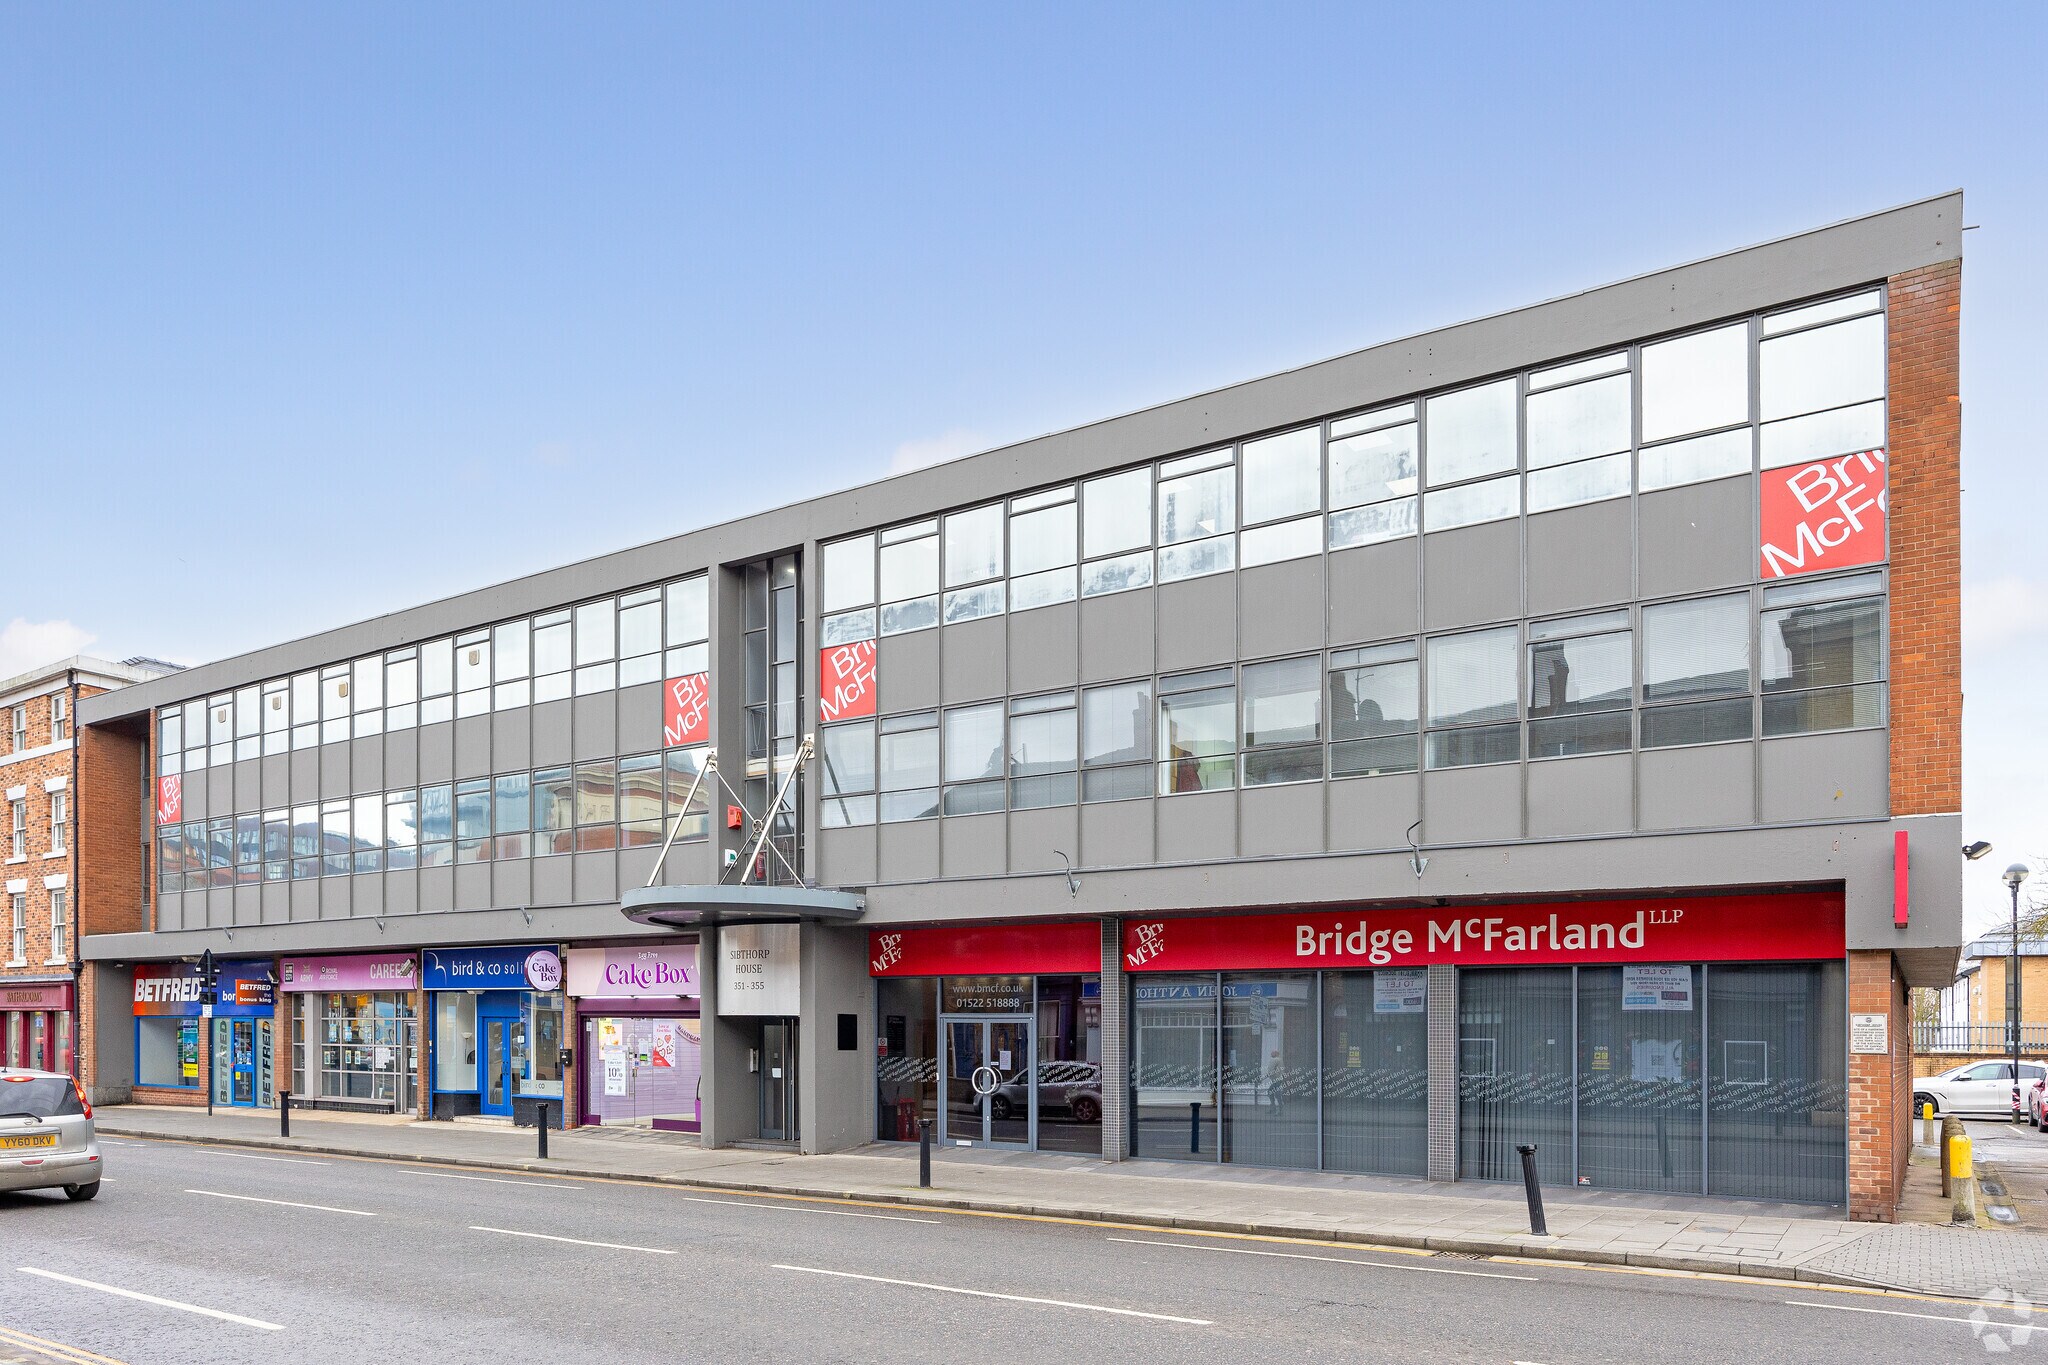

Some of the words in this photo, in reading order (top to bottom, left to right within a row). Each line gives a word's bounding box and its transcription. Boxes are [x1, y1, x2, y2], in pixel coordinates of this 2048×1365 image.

[673, 672, 708, 708] Bri
[664, 692, 709, 746] McF
[163, 774, 181, 798] Bri
[158, 788, 181, 824] McF
[1296, 921, 1412, 964] Bridge
[1428, 911, 1644, 952] McFarland
[1649, 910, 1684, 924] LLP
[730, 950, 770, 959] SIBTHORP
[370, 963, 413, 979] CAREE
[452, 960, 472, 976] bird
[476, 961, 485, 975] &
[488, 963, 500, 975] co
[532, 962, 556, 975] Cake
[606, 962, 651, 989] Cake
[656, 962, 691, 984] Box
[736, 964, 762, 974] HOUSE
[300, 974, 313, 982] ARMY
[541, 973, 558, 982] Box
[134, 977, 202, 1002] BETFRED
[734, 982, 744, 990] 351
[751, 982, 764, 990] 355
[953, 984, 1024, 993] www.bmcf.co.uk
[956, 998, 984, 1008] 01522
[986, 998, 1020, 1007] 518888
[263, 1021, 271, 1105] BETFRED
